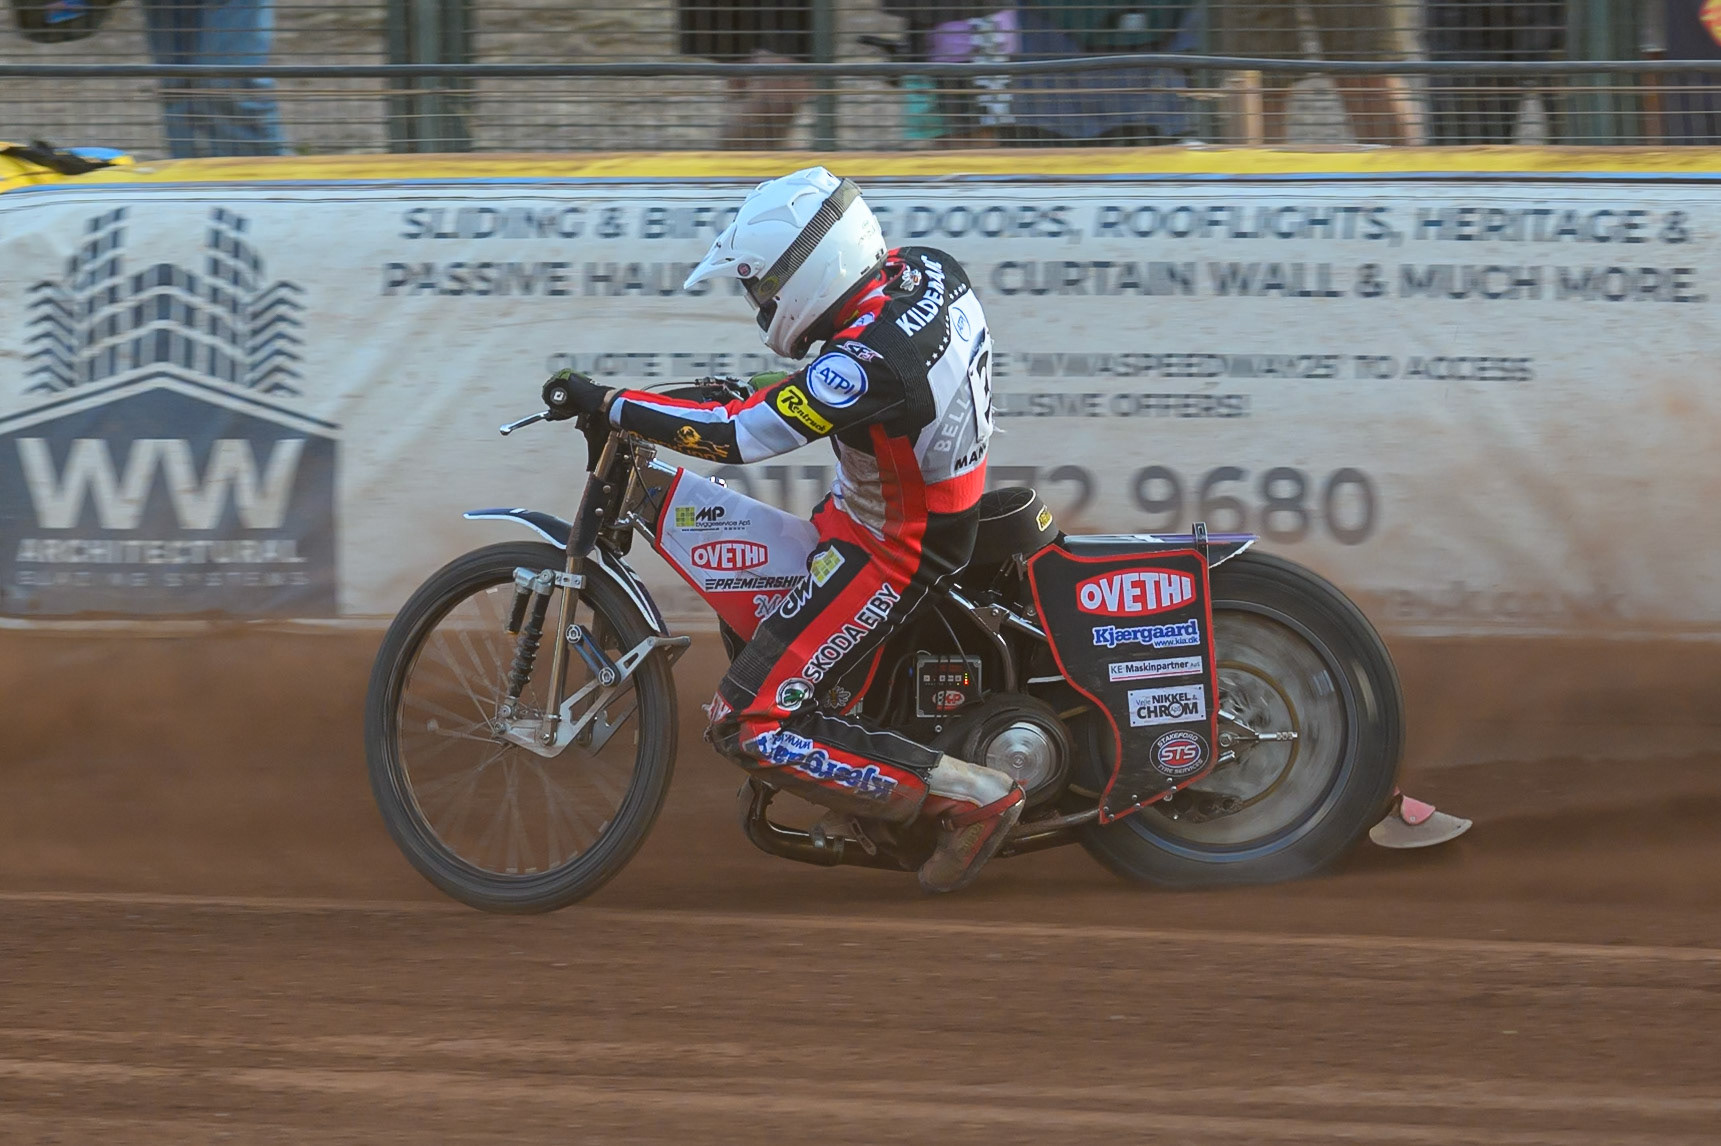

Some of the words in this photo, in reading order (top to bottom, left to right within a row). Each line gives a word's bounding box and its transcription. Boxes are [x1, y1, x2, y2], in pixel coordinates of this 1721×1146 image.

[400, 207, 586, 238] SLIDING
[597, 207, 623, 238] &
[903, 206, 1083, 244] DOORS,
[1095, 206, 1403, 247] ROOFLIGHTS,
[1414, 207, 1648, 243] HERITAGE
[1656, 211, 1690, 244] &
[383, 262, 570, 296] PASSIVE
[992, 261, 1195, 297] CURTAIN
[1207, 262, 1345, 298] WALL
[1354, 263, 1389, 298] &
[1399, 264, 1546, 300] MUCH
[1553, 266, 1708, 303] MORE.
[818, 366, 856, 395] ATPI
[1353, 355, 1398, 380] TO
[1402, 356, 1535, 382] ACCESS
[780, 388, 827, 433] Rentruck
[15, 438, 306, 529] WW
[695, 506, 725, 522] MP
[1131, 465, 1378, 546] 9680
[693, 543, 766, 569] OVETHI
[1080, 572, 1192, 612] OVETHI
[1093, 620, 1198, 647] Kjærgaard
[801, 623, 869, 684] SKODA
[1111, 665, 1123, 674] KE
[1125, 661, 1189, 674] Maskinpartner
[1136, 702, 1199, 719] CHROM
[1152, 692, 1191, 704] NIKKEL
[1160, 745, 1197, 761] STS
